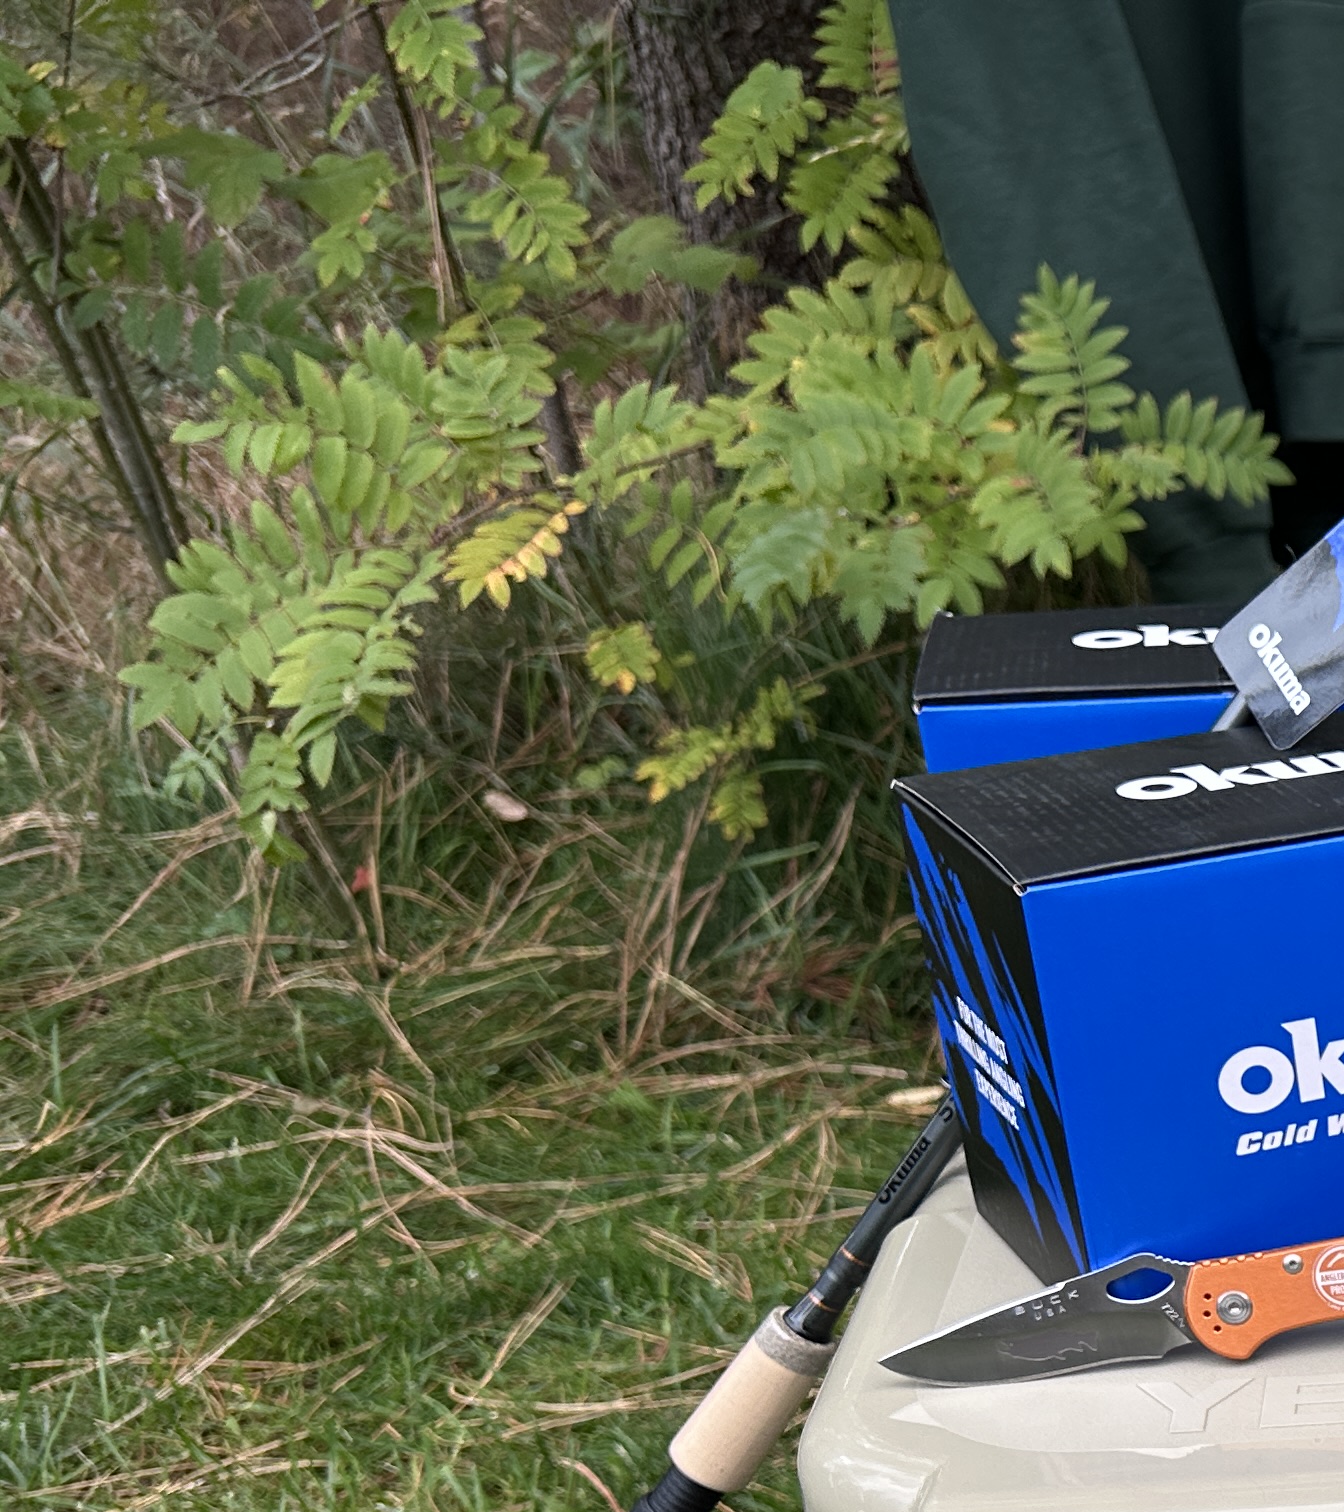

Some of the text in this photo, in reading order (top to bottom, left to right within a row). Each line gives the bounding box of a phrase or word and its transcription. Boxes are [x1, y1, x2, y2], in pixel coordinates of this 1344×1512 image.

[1248, 623, 1311, 715] okuma
[1236, 1118, 1318, 1156] Cold
[878, 1136, 932, 1205] okuma
[1321, 1272, 1344, 1283] ANGLER
